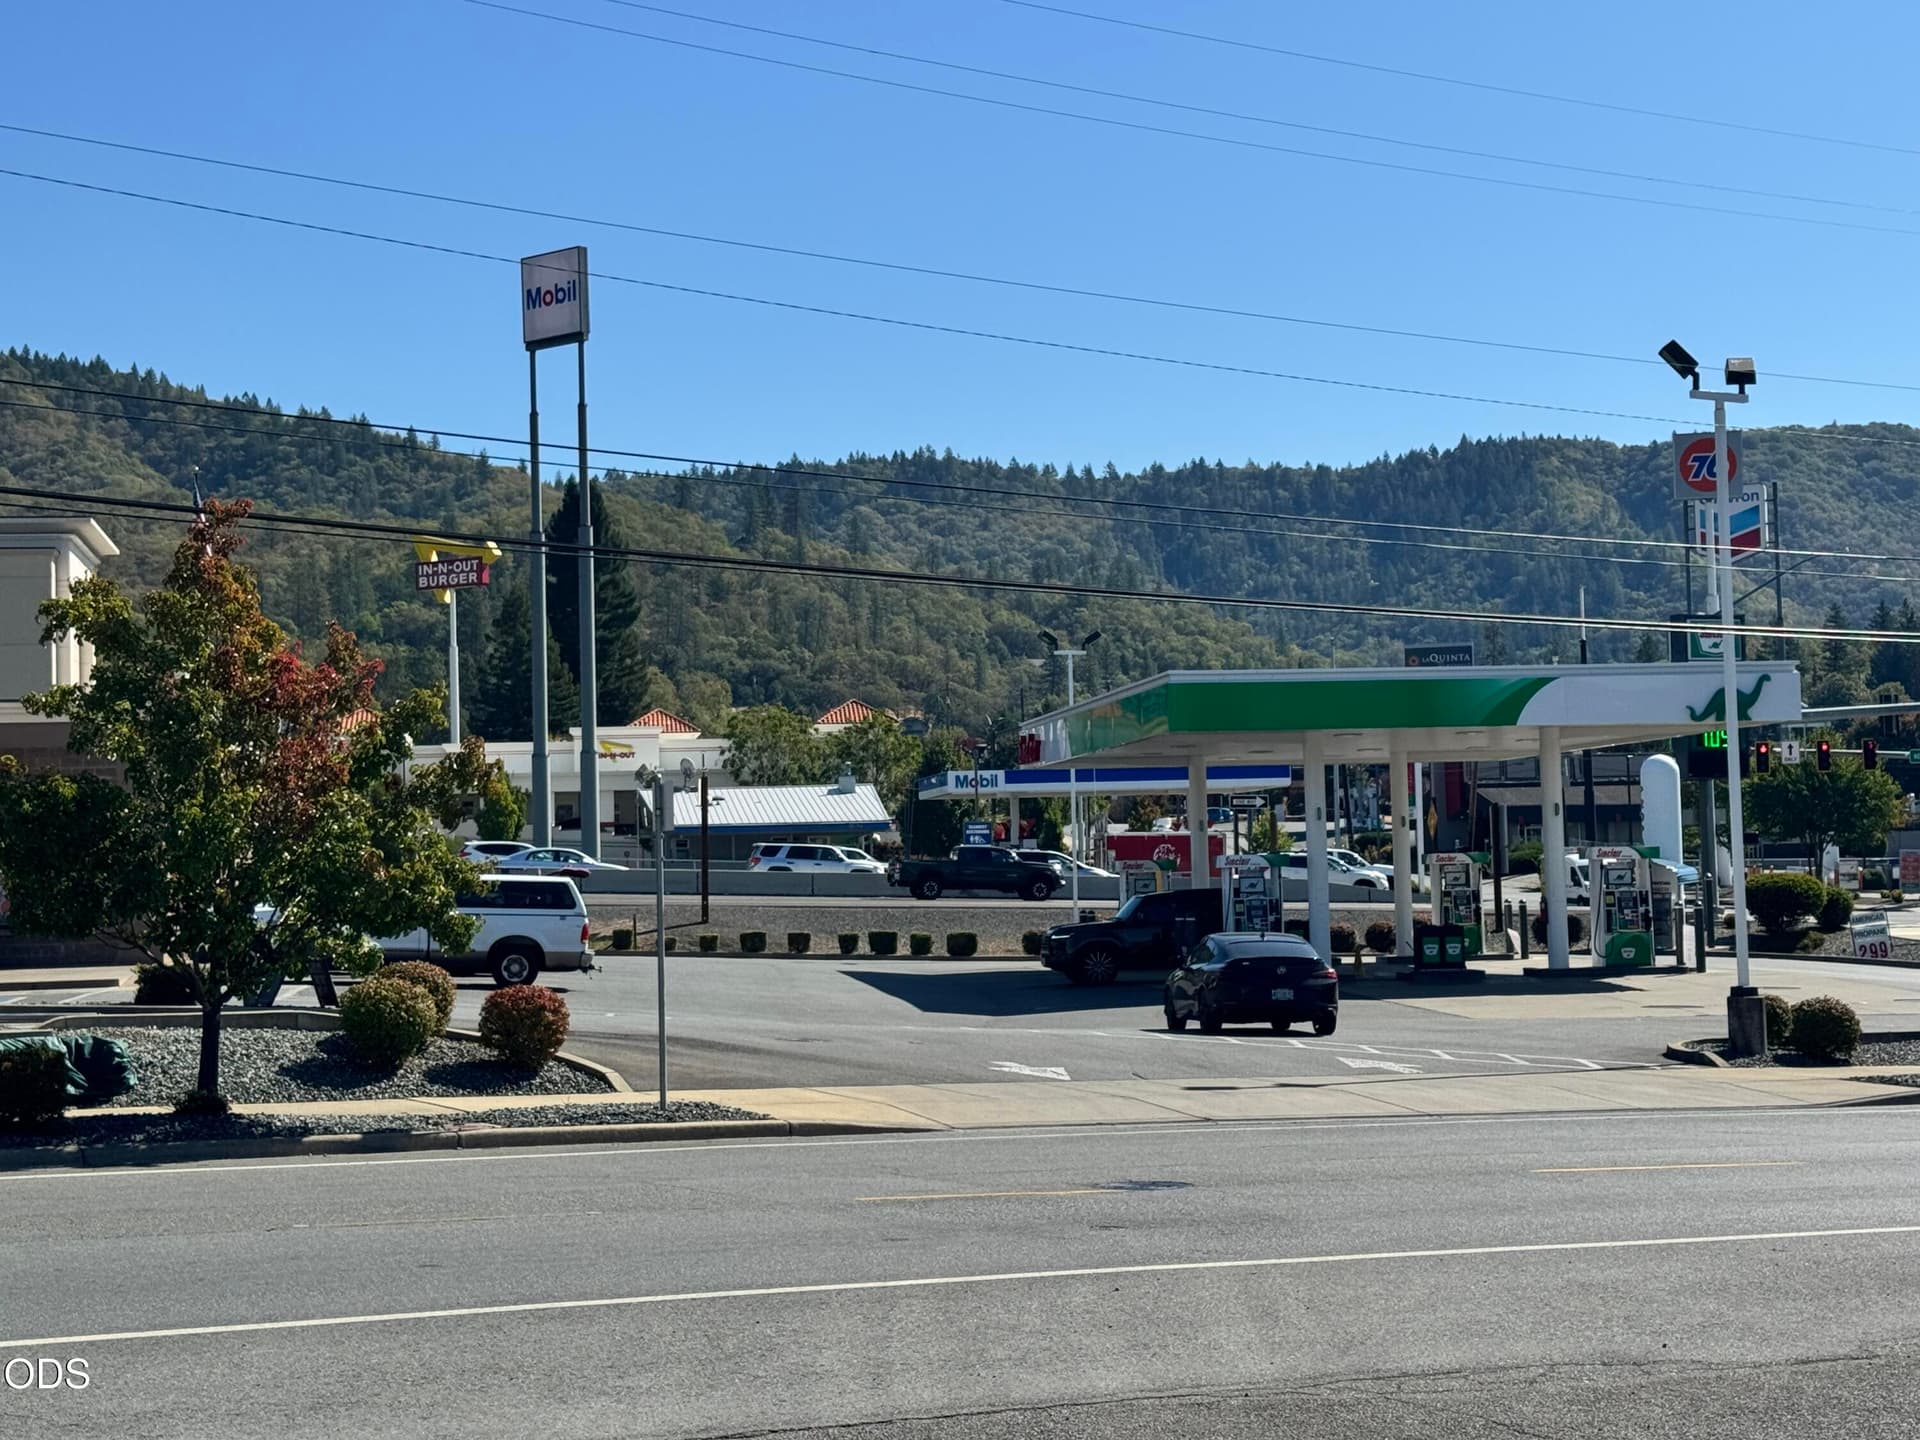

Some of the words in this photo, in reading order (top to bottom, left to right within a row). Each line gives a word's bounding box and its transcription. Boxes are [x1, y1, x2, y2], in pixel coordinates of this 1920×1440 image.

[526, 280, 577, 310] Mobil
[418, 560, 479, 575] IN-N-OUT
[419, 572, 478, 587] BURGER
[955, 774, 998, 788] Mobil
[1596, 848, 1622, 858] Sinclair
[1224, 855, 1251, 866] Sinclair
[1855, 926, 1888, 938] PROPANE
[1859, 941, 1889, 958] 299
